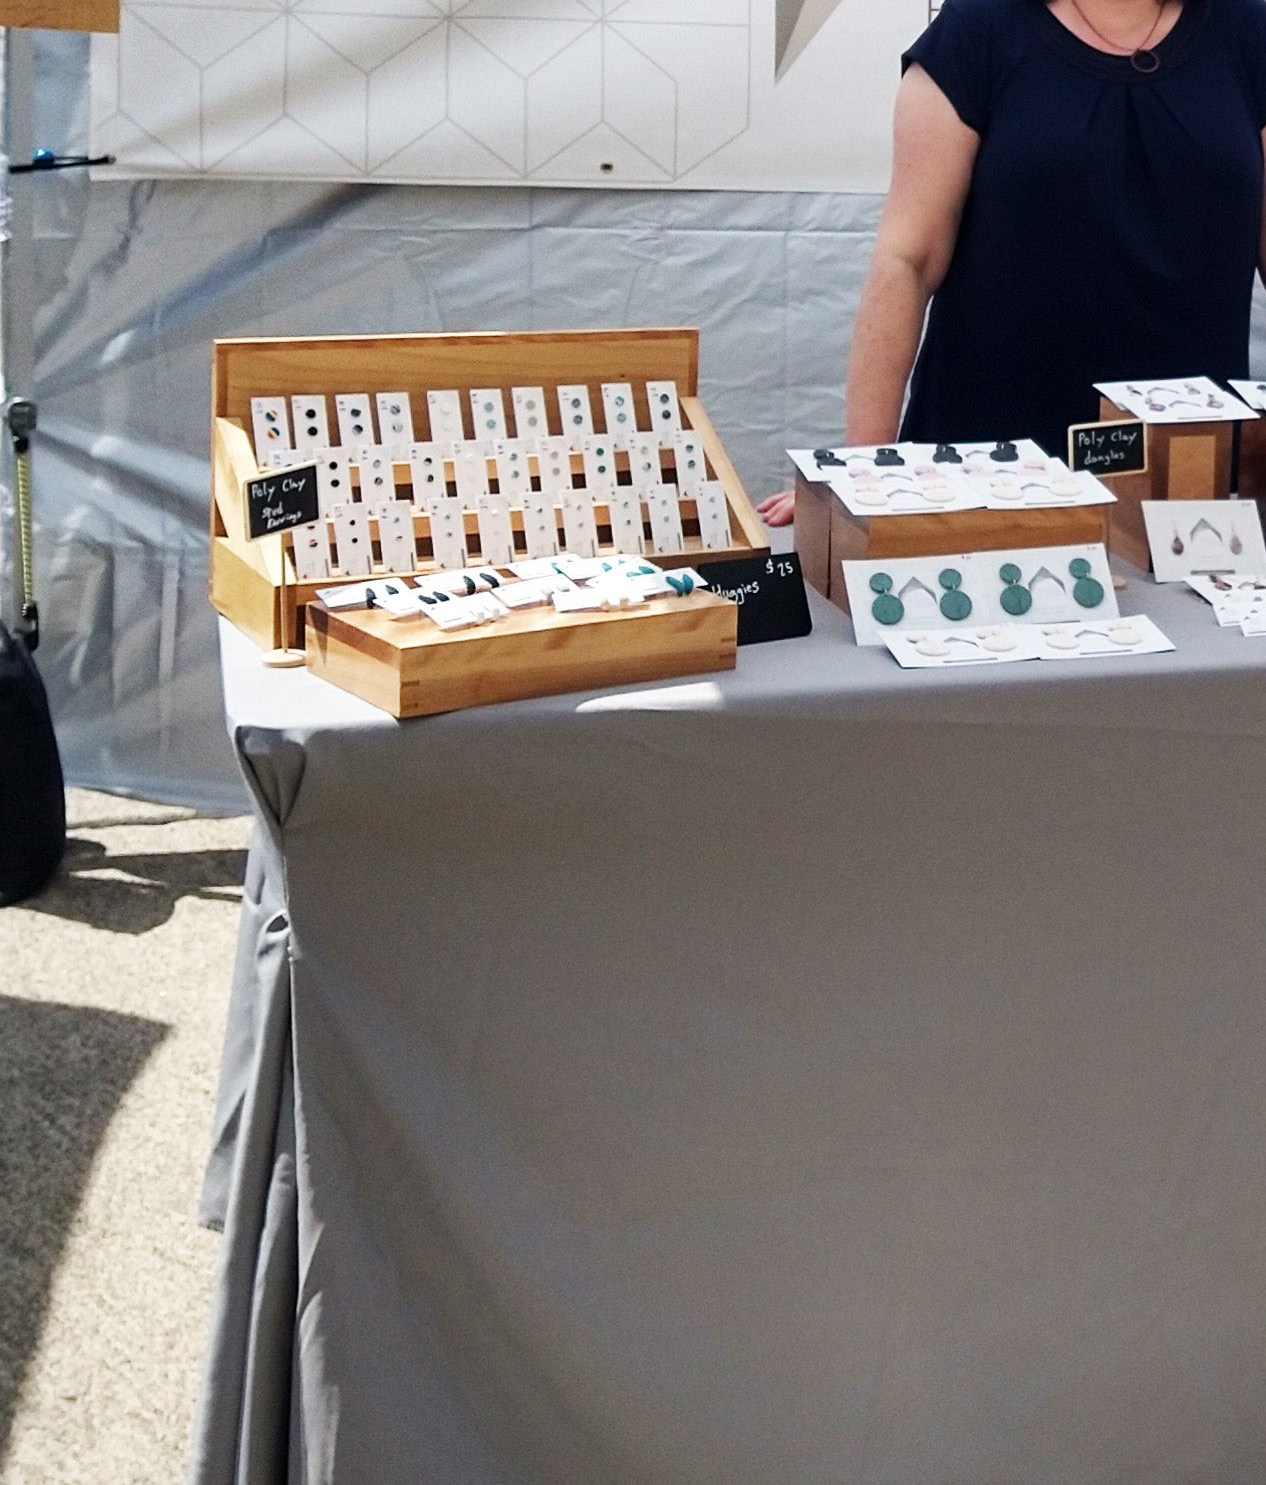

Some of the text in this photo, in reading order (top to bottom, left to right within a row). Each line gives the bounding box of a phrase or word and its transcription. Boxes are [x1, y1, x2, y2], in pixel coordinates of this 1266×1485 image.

[1078, 430, 1137, 448] Poly Clay
[251, 478, 306, 502] Poly Clay
